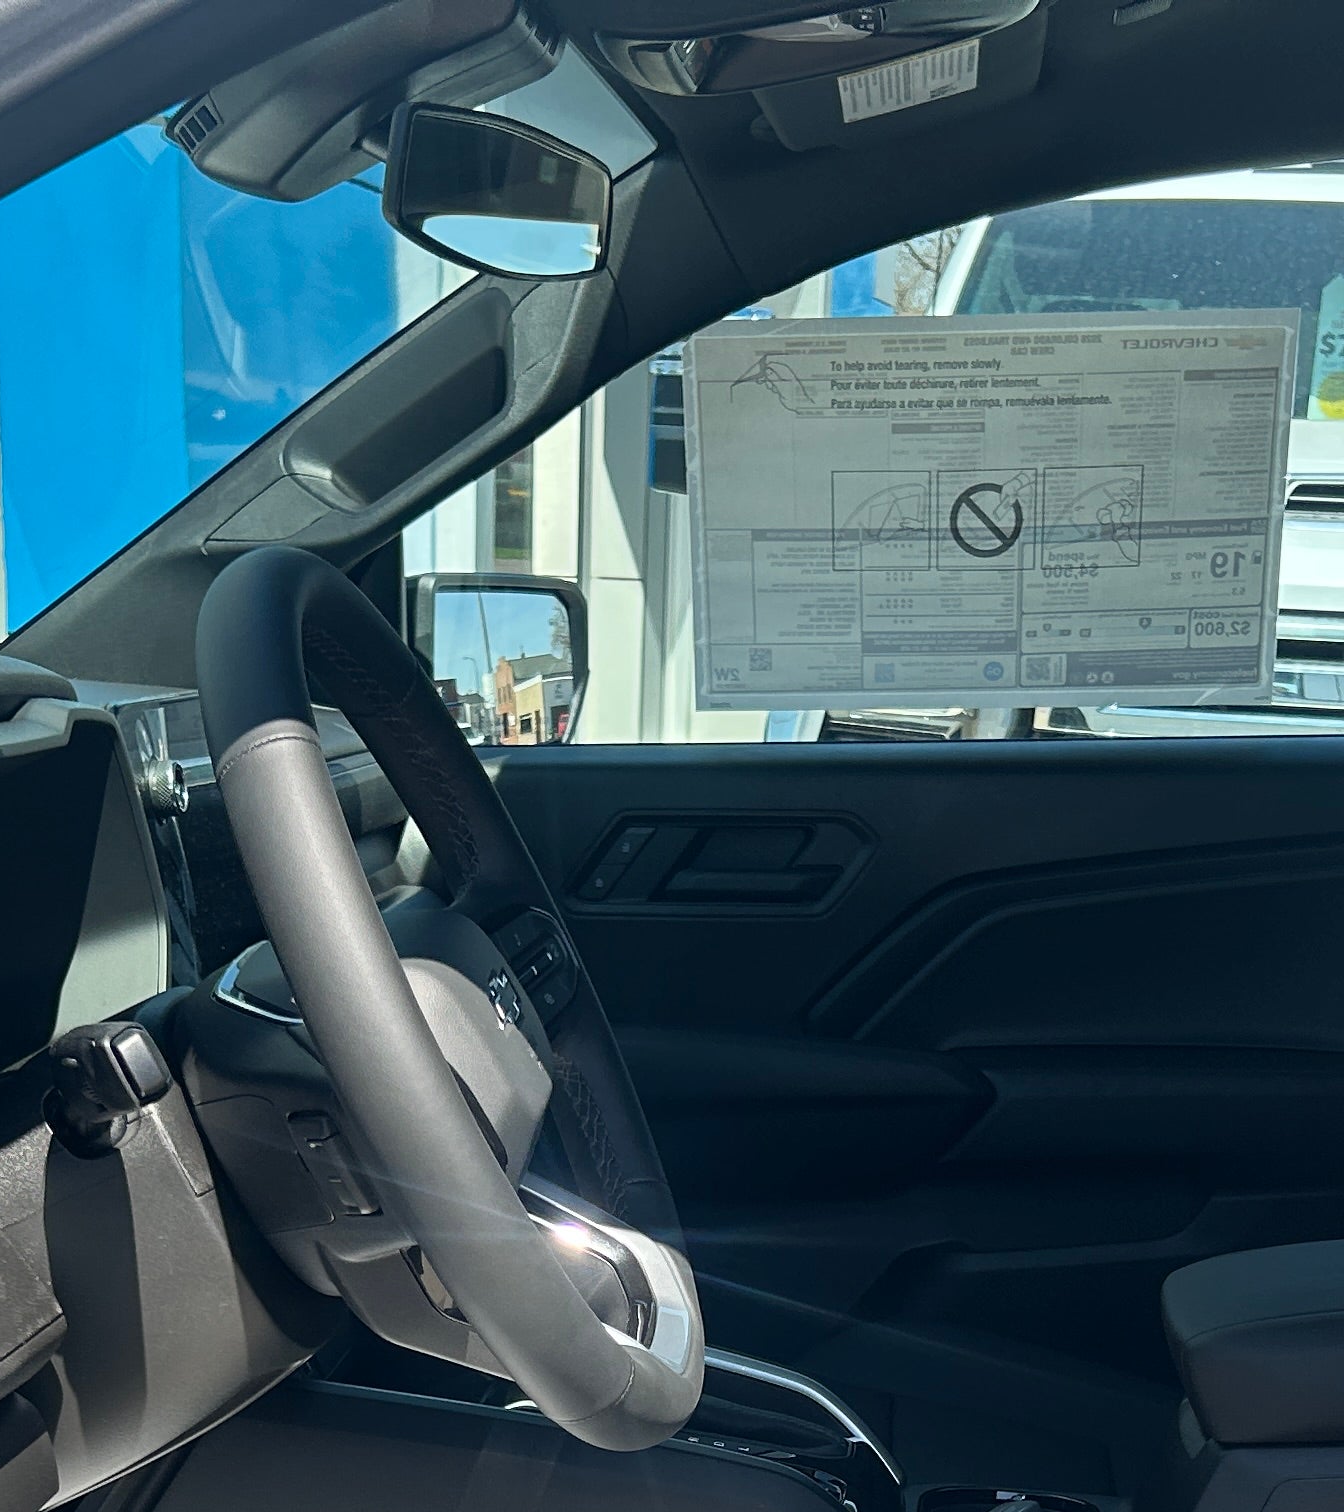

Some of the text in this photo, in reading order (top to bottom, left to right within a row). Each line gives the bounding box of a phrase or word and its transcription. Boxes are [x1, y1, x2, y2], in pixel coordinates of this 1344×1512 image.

[830, 359, 1003, 374] To help avoid tearing, remove slowly.
[830, 378, 852, 390] Pour
[883, 378, 907, 390] toute
[910, 377, 957, 392] déchirure,
[959, 378, 987, 390] retirer
[830, 398, 852, 409] Para
[854, 398, 896, 412] ayudarse
[898, 400, 906, 409] a
[908, 398, 934, 409] evitar
[936, 400, 953, 412] que
[956, 399, 968, 409] se
[970, 400, 1003, 411] rompa,
[1057, 395, 1113, 407] lentamente.
